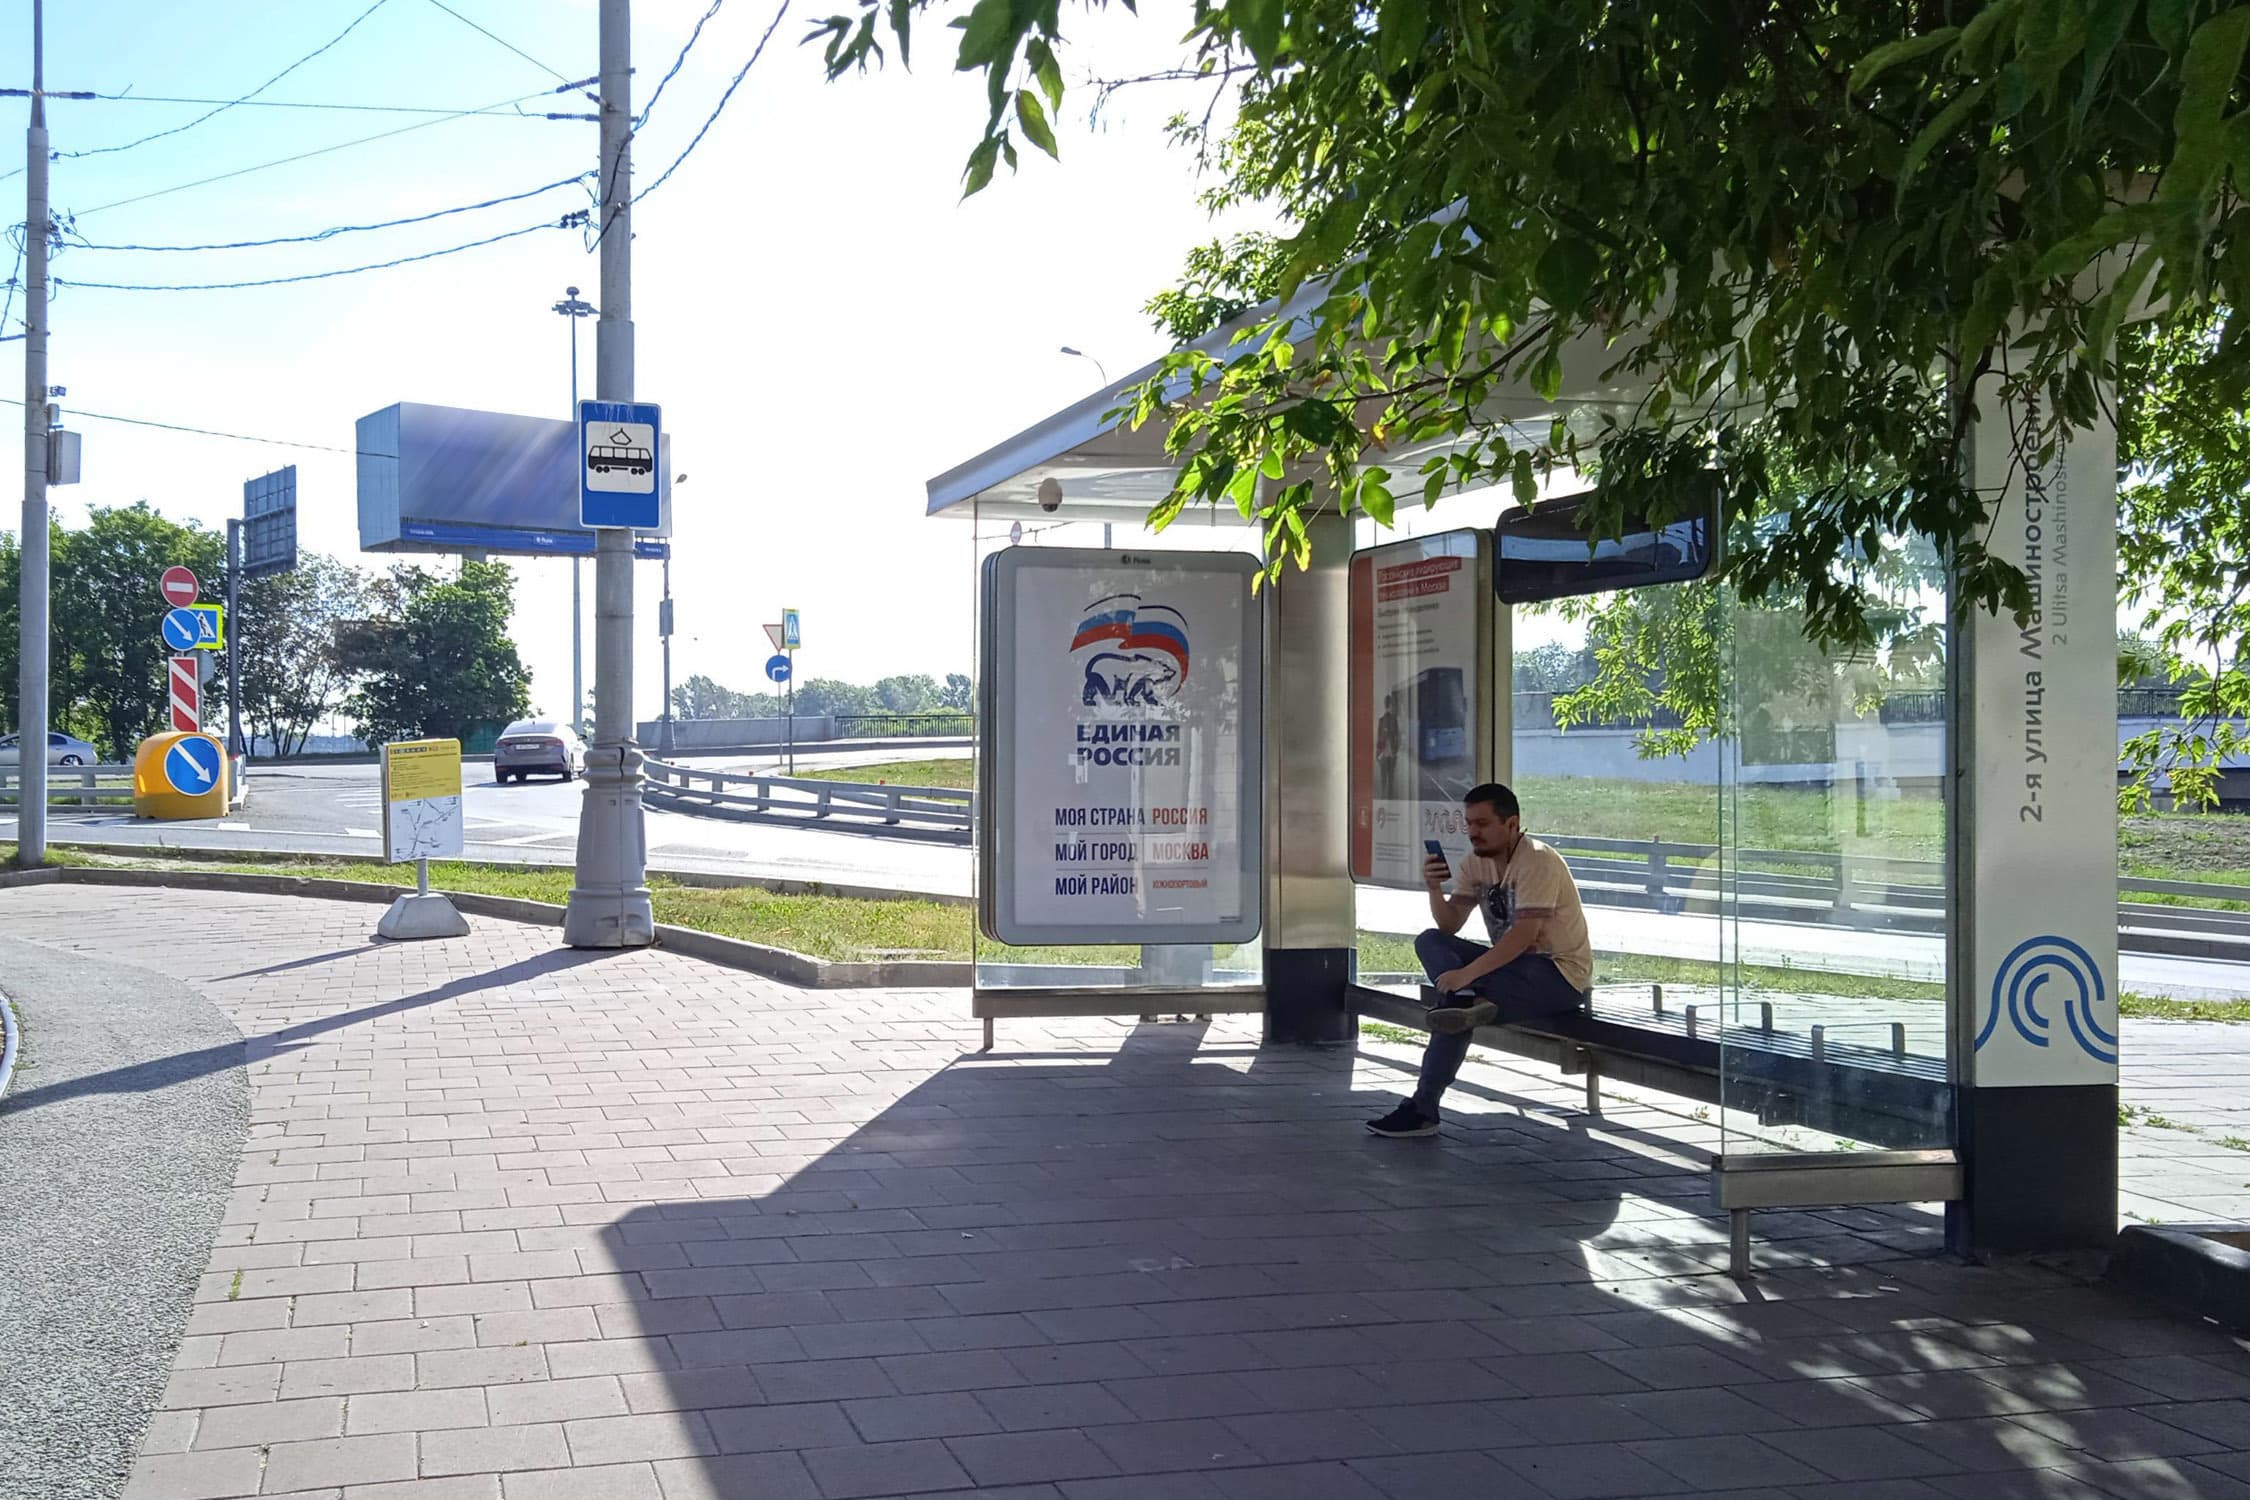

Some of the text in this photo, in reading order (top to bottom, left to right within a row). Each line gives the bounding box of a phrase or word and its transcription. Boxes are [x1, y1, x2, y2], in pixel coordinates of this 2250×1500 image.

[2051, 573, 2068, 626] Ulitsa
[2051, 634, 2068, 646] 2
[2022, 671, 2047, 764] улица
[1076, 724, 1180, 744] ЕДИНАЯ
[1076, 747, 1180, 766] РОССИЯ
[2019, 773, 2043, 823] 2-я
[1055, 807, 1208, 826] МОЯ СТРАНА РОССИЯ
[1055, 839, 1209, 862] МОЙ ГОРОД МОСКВА
[1055, 873, 1087, 896] МОЙ
[1091, 873, 1138, 895] РАЙОН
